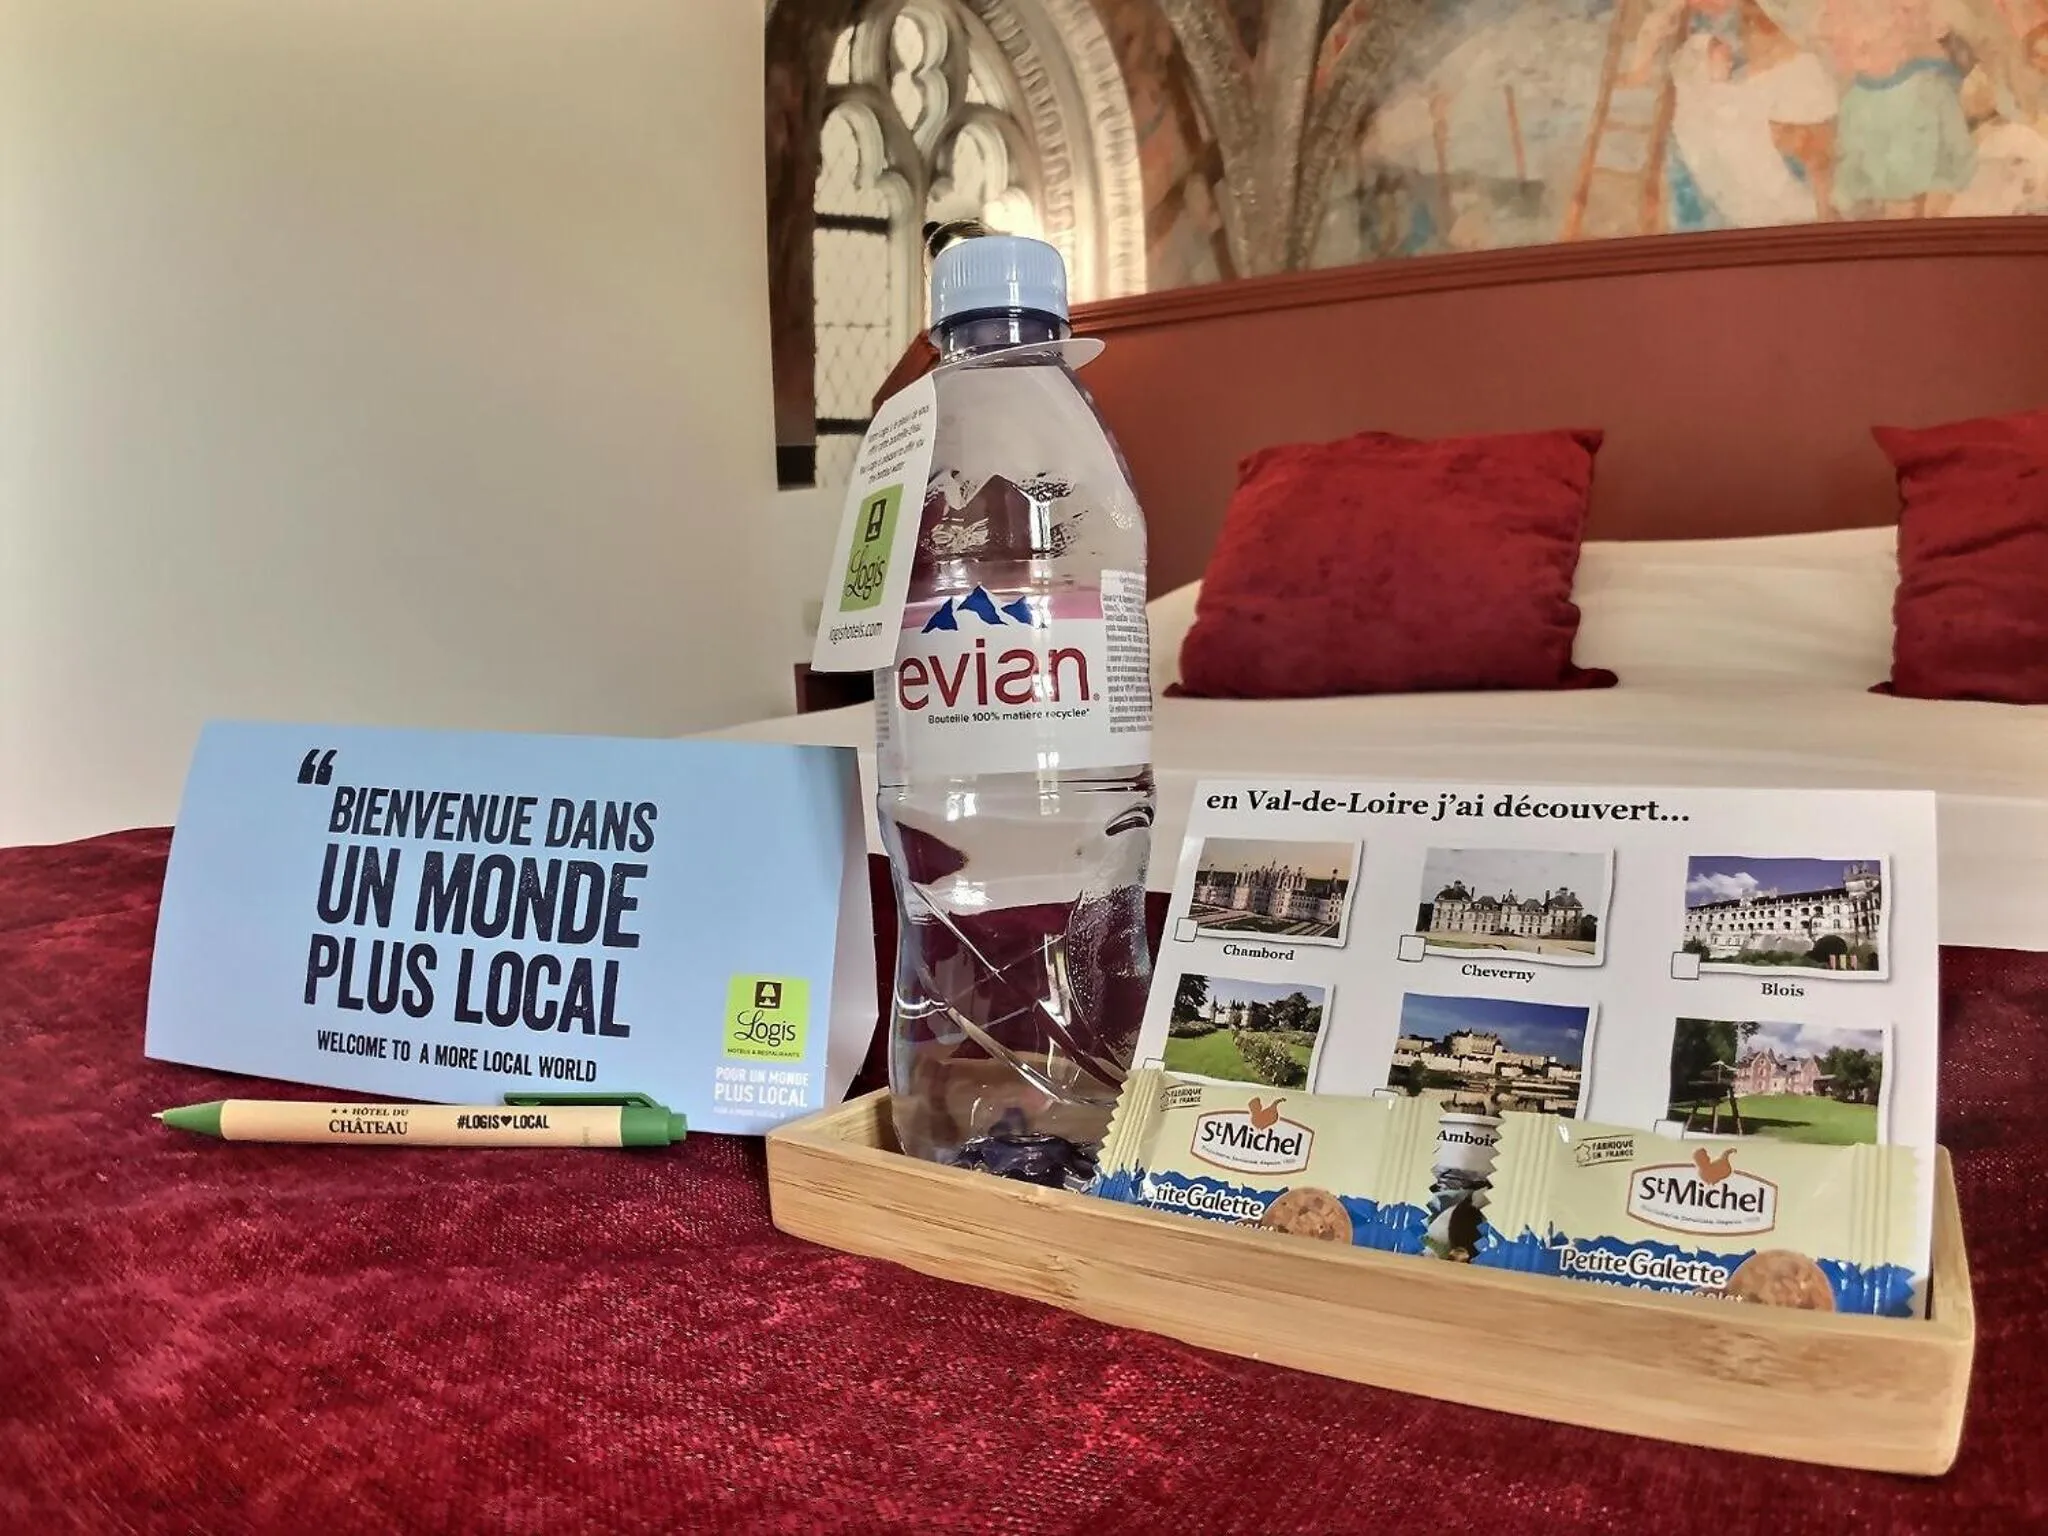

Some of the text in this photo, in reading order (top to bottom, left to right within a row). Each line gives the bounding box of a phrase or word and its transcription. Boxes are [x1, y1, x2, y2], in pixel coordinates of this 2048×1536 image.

[845, 545, 885, 600] Logis
[899, 638, 1089, 711] evian
[972, 711, 1000, 721] 100%
[328, 786, 658, 853] BIENVENUE DANS
[1206, 794, 1238, 809] en
[1247, 789, 1429, 814] Val-de-Loire
[1431, 793, 1484, 821] j'ai
[317, 843, 648, 948] UN MONDE
[1223, 944, 1295, 960] Chambord
[304, 933, 630, 1038] PLUS LOCAL
[1461, 963, 1536, 983] Cheverny
[1761, 982, 1804, 996] Blois
[734, 1009, 796, 1047] Logis
[317, 1029, 597, 1083] WELCOME TO A MORE LOCAL WORLD
[716, 1066, 809, 1087] POUR UN MONDE
[714, 1082, 808, 1108] PLUS LOCAL
[328, 1117, 408, 1135] CHÂTEAU
[352, 1107, 409, 1116] HÔTEL DU
